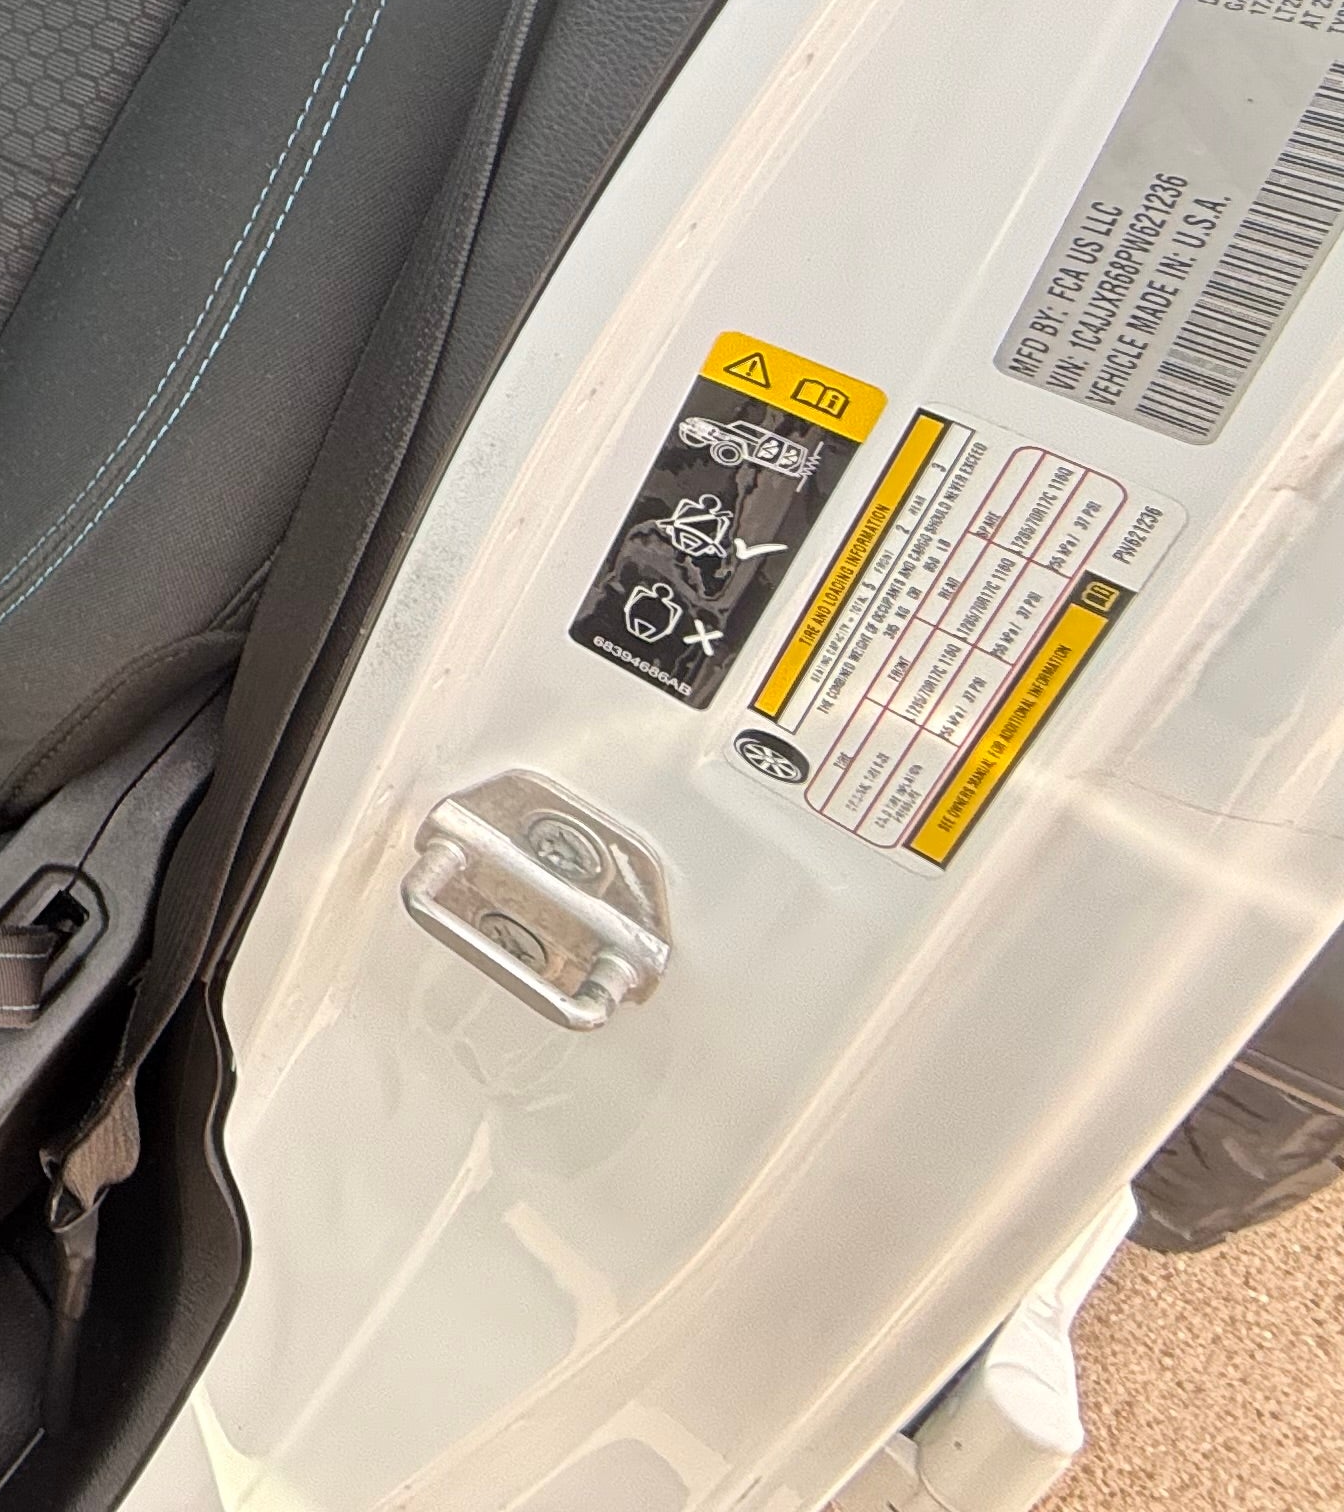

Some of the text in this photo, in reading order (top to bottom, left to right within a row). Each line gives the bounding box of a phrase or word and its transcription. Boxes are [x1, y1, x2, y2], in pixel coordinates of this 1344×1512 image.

[1299, 11, 1325, 30] AT
[1007, 200, 1123, 377] MFD BY: FCA US LLC
[1045, 171, 1189, 389] VIN: 1C4JJXR68PW621236
[1084, 196, 1231, 405] VEHICLE MADE IN: U.S.A.
[896, 524, 909, 535] 2
[932, 463, 946, 472] 3
[1113, 506, 1163, 564] PW621236
[799, 503, 889, 647] TIRE AND LOADING INFORMATION
[818, 442, 987, 715] THE COMBINED WEIGHT OF OCCUPANTS AND CARGO SHOULD NEVER EXCEED
[939, 577, 959, 600] REAR
[895, 606, 909, 620] KG
[593, 635, 692, 696] 68394686AB
[888, 656, 910, 683] FRONT
[988, 740, 1006, 759] FOR
[999, 697, 1035, 742] ADDITIONAL
[1028, 644, 1071, 699] INFORMATION
